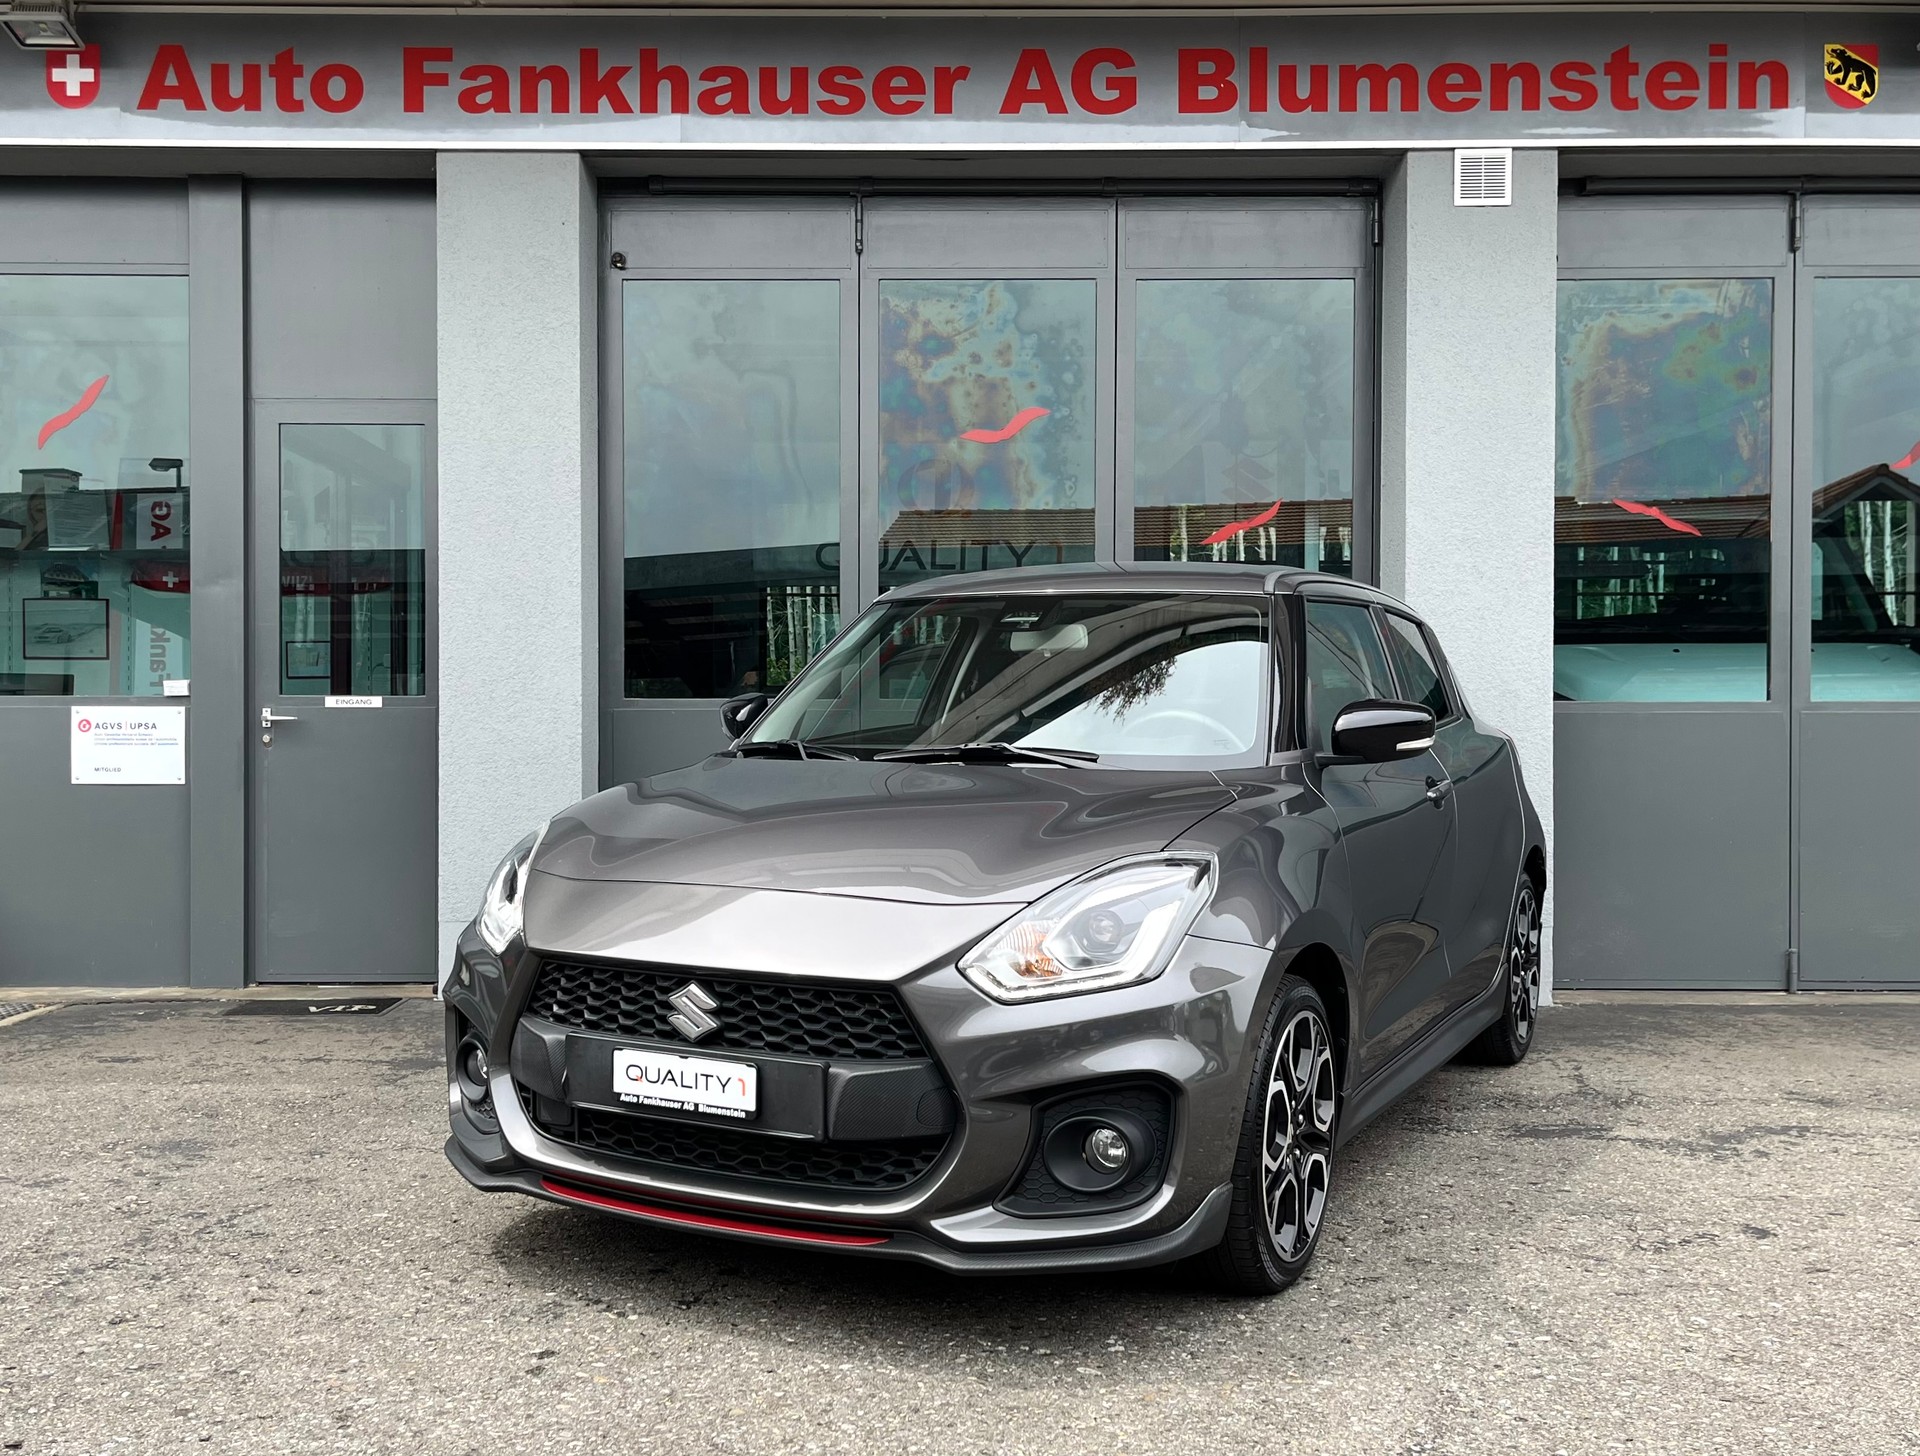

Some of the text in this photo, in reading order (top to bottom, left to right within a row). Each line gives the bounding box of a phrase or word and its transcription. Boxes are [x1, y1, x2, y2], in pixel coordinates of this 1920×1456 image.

[137, 43, 1790, 116] Auto Fankhauser AG Blumenstein
[335, 698, 373, 706] EINGANG
[94, 722, 158, 730] AGVS UPSA
[625, 1064, 732, 1093] QUALITY
[620, 1093, 746, 1119] Auto Fankhauser AG Blumenstein
